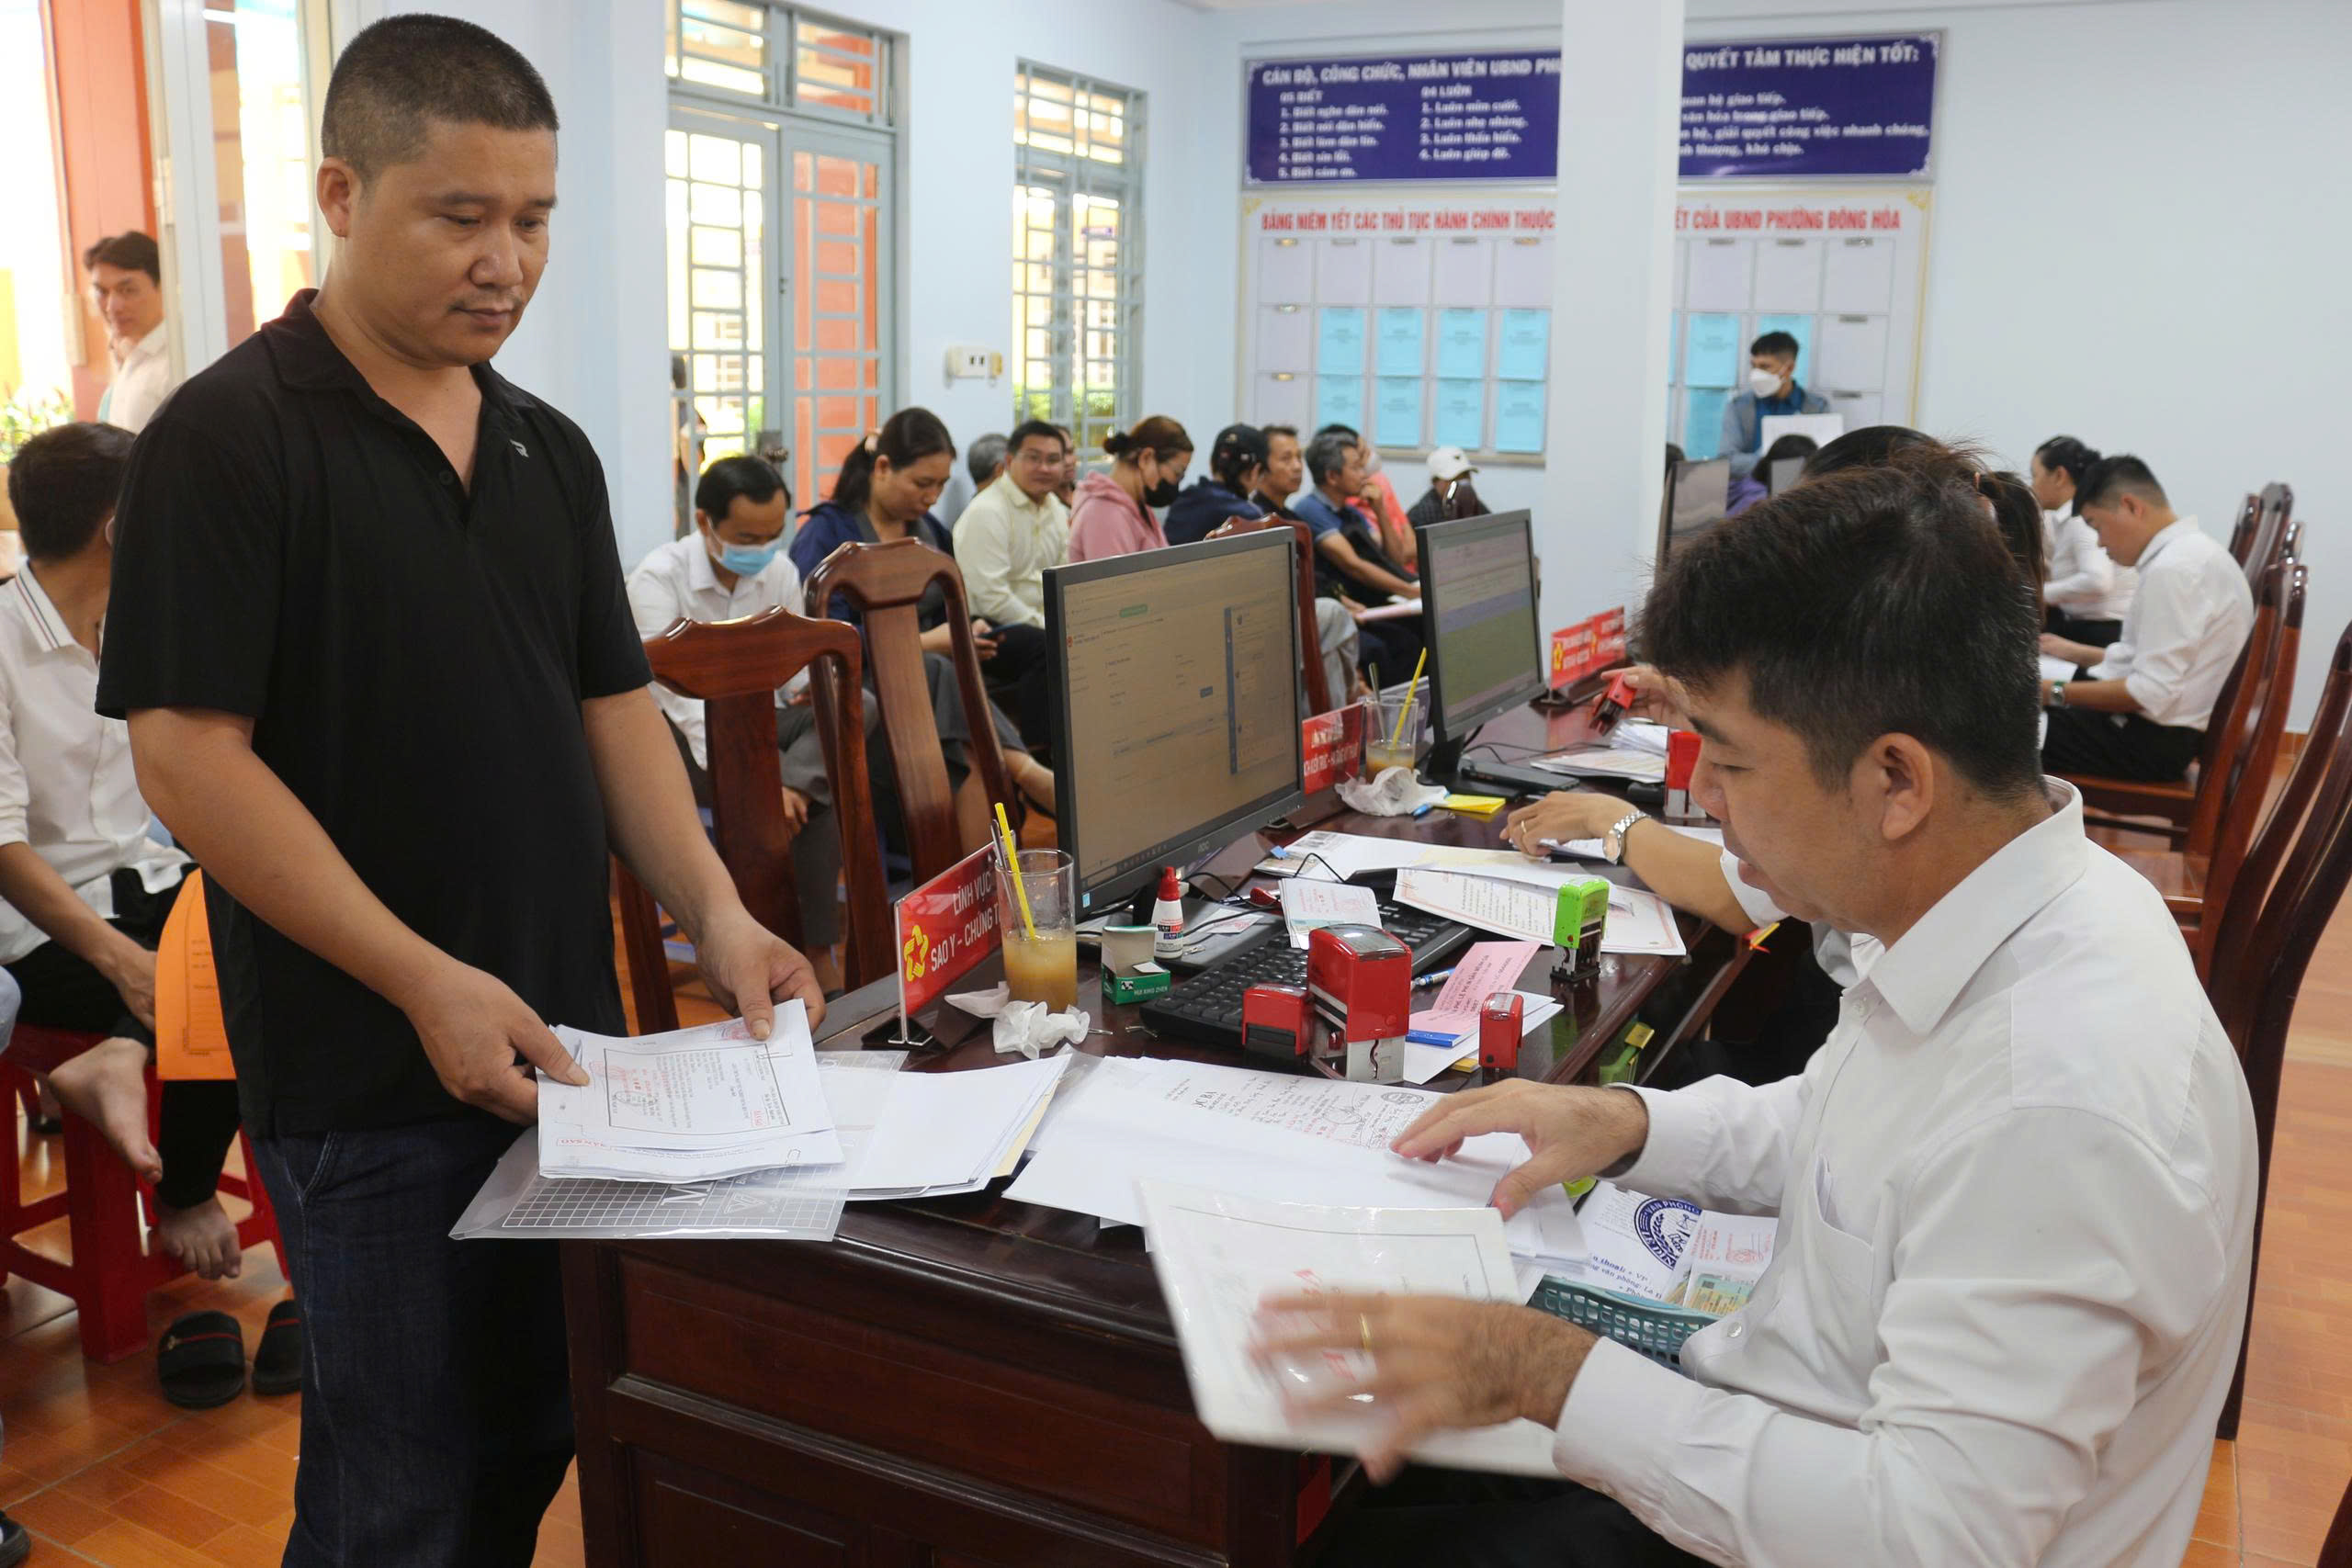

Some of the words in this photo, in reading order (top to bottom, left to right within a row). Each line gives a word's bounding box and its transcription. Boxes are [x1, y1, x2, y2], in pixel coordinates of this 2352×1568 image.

[1685, 46, 1739, 72] QUYẾT
[1745, 47, 1781, 69] TÂM
[1785, 46, 1831, 70] THỰC
[1834, 43, 1876, 67] HIỆN
[1880, 39, 1919, 63] TỐT:
[1261, 66, 1292, 85] CÁN
[1320, 63, 1360, 84] CÔNG
[1408, 58, 1450, 79] NHÂN
[1451, 57, 1487, 78] VIÊN
[1488, 59, 1532, 76] UBND
[1439, 83, 1473, 98] LUÔN
[1842, 123, 1883, 137] nhanh
[1354, 207, 1378, 230] CÁC
[1724, 209, 1762, 230] UBND
[931, 940, 949, 972] SAO
[949, 933, 956, 957] Y
